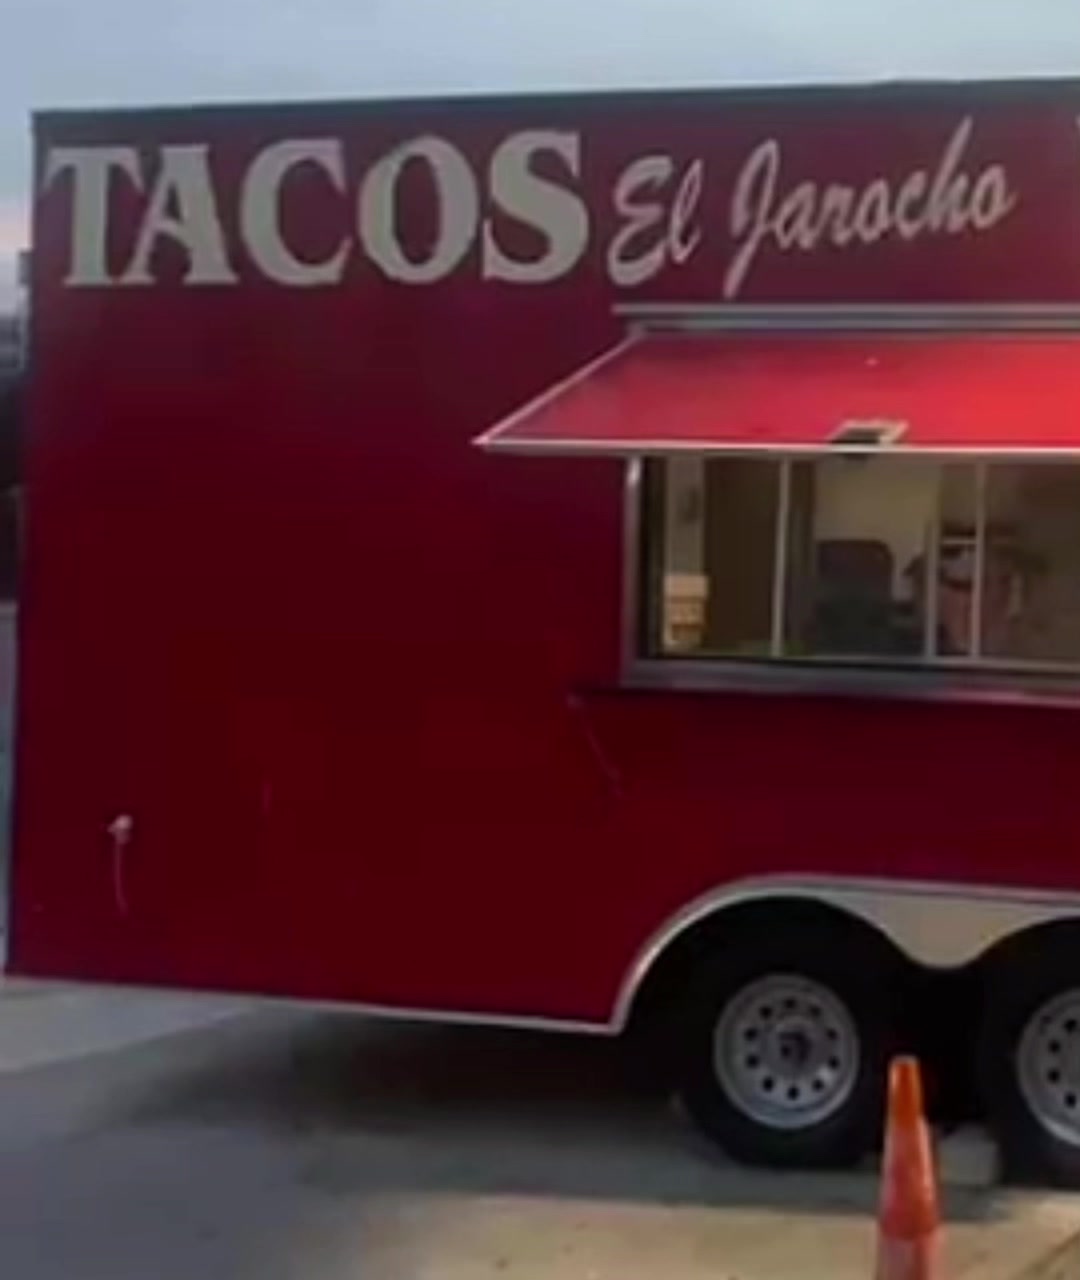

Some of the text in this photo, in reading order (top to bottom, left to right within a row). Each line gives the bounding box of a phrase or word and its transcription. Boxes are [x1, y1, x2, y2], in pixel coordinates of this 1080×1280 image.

[44, 131, 590, 287] TACOS
[608, 156, 702, 286] El
[724, 118, 1013, 300] Jarocho
